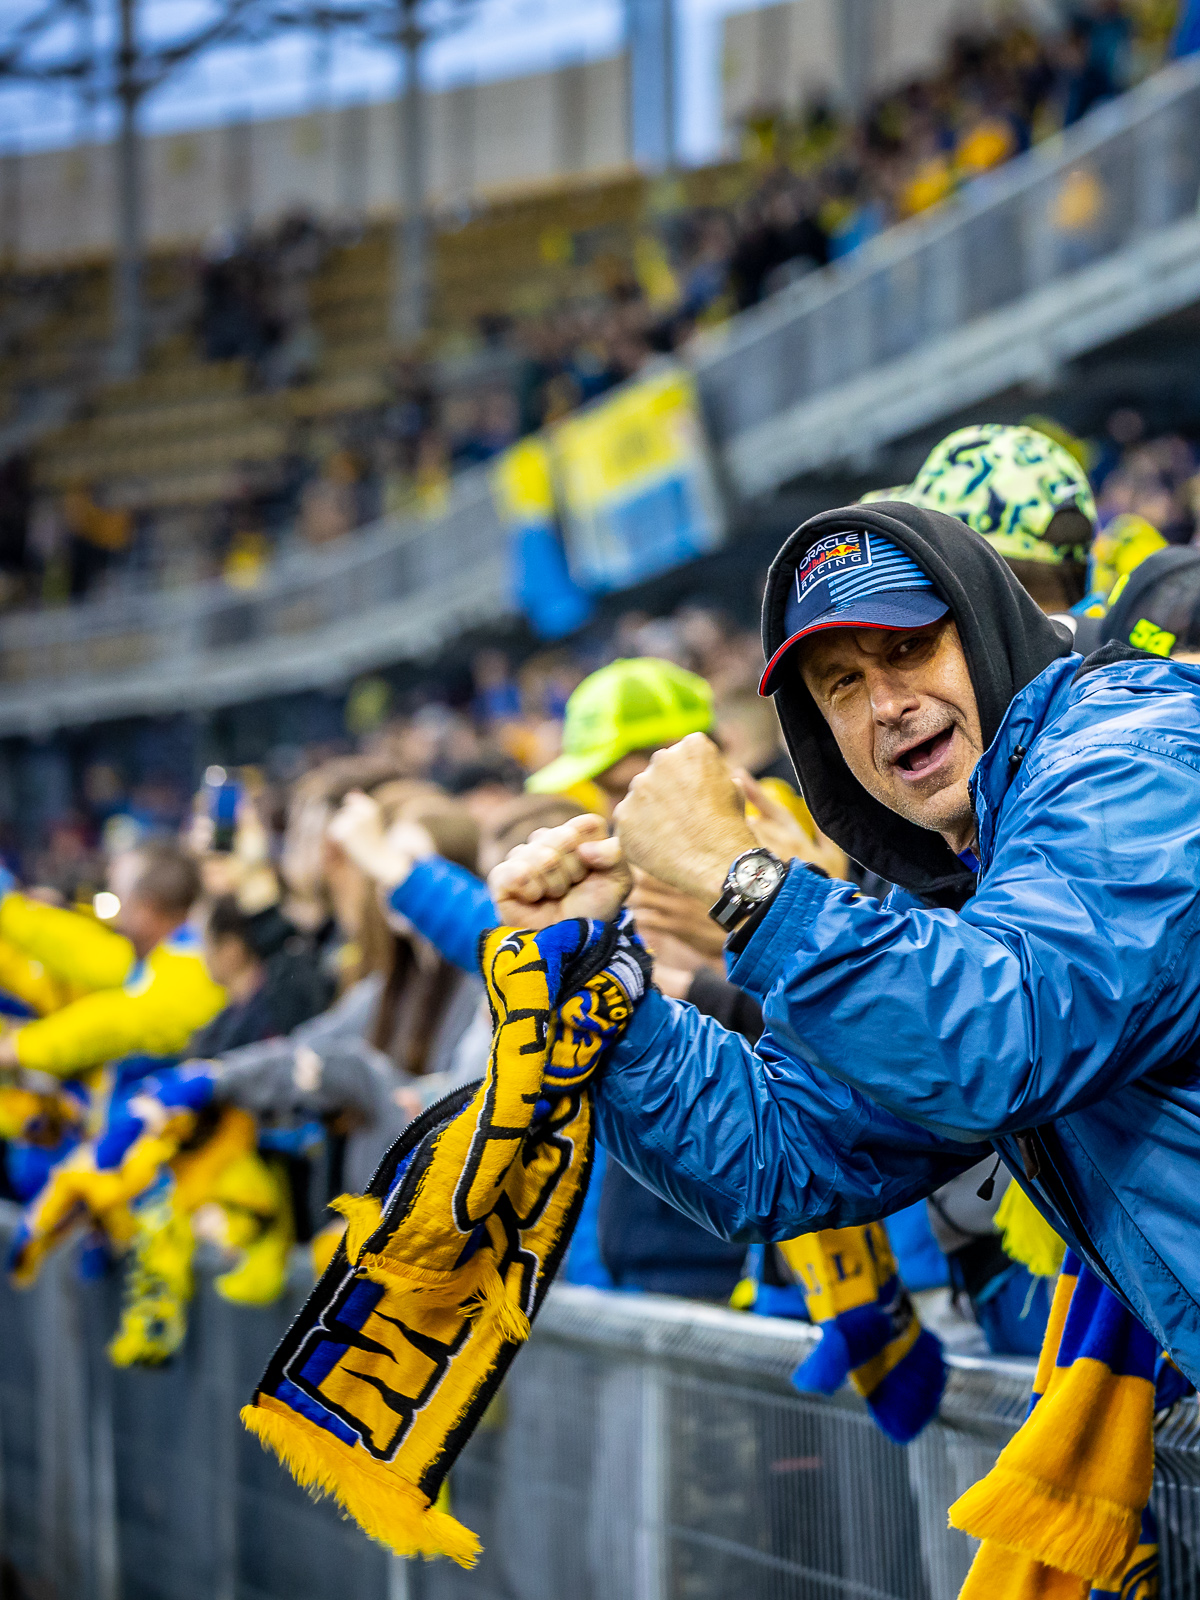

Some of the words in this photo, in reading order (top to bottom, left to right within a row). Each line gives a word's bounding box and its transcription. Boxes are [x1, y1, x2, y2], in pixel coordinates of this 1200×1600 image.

[800, 533, 859, 569] ORACLE
[800, 563, 812, 582] Red
[811, 552, 826, 569] Bull
[801, 553, 862, 591] RACING
